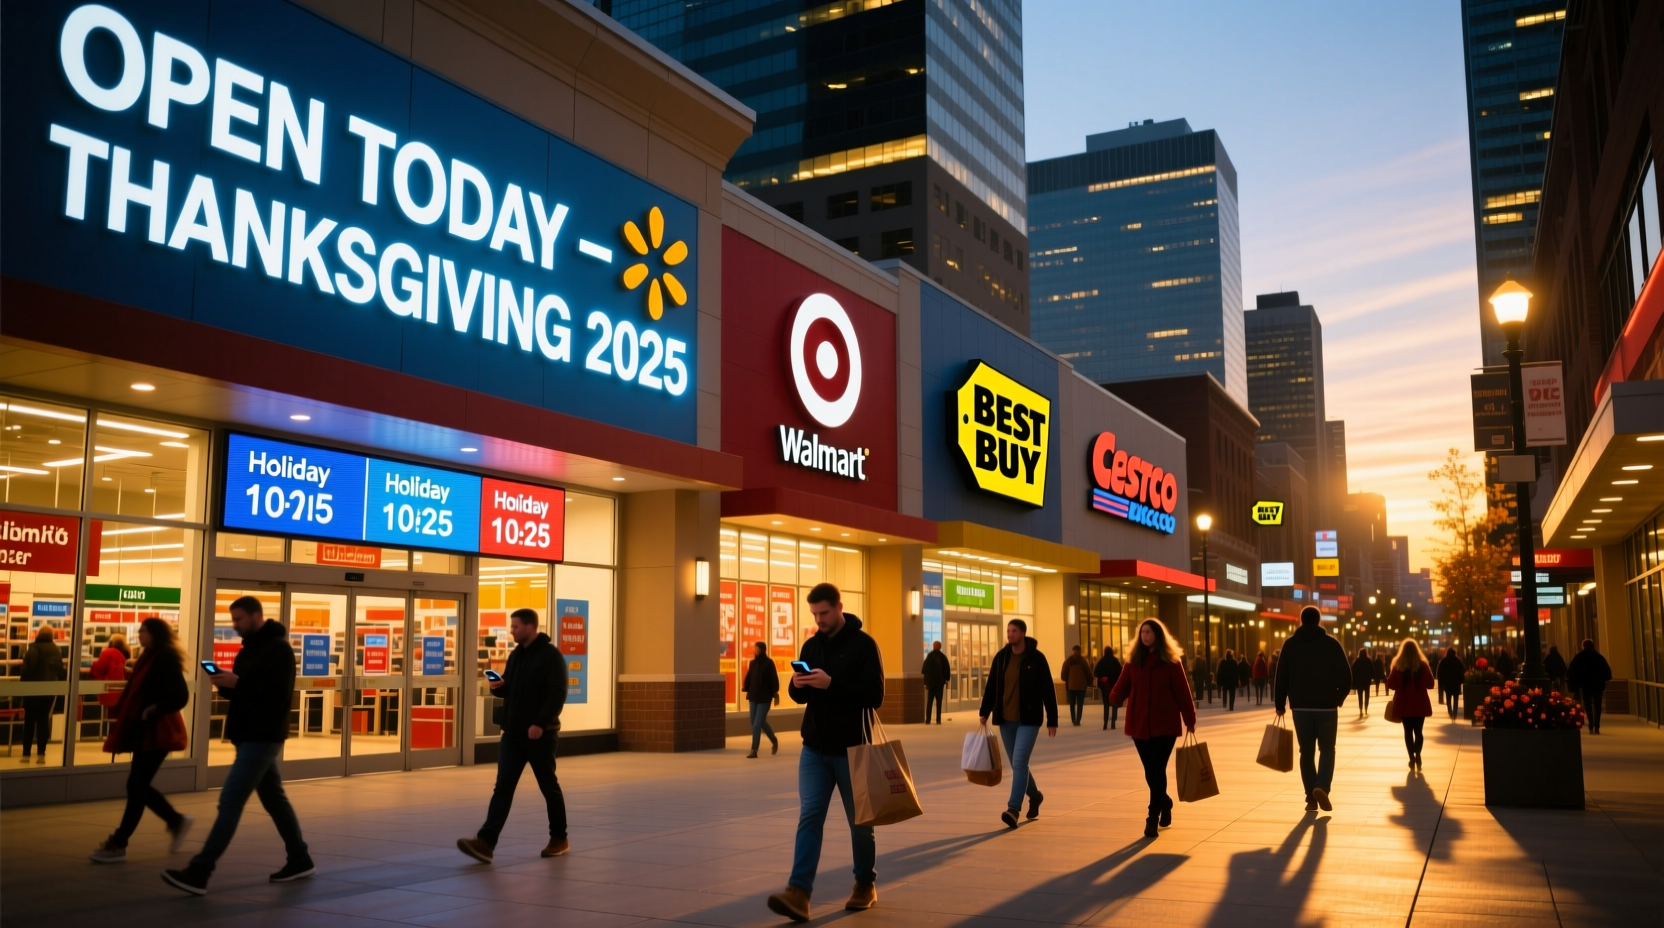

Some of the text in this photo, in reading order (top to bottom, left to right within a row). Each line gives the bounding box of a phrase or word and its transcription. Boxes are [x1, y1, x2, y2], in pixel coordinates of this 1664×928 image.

[60, 3, 325, 185] OPEN
[348, 114, 569, 271] TODAY
[49, 123, 688, 397] THANKSGIVING 2025
[974, 383, 1046, 447] BEST
[249, 450, 331, 488] Holiday
[780, 424, 866, 481] Walmart
[975, 429, 1041, 485] BUY
[385, 472, 450, 505] Holiday
[494, 489, 549, 520] Holiday
[491, 516, 550, 548] 10:25
